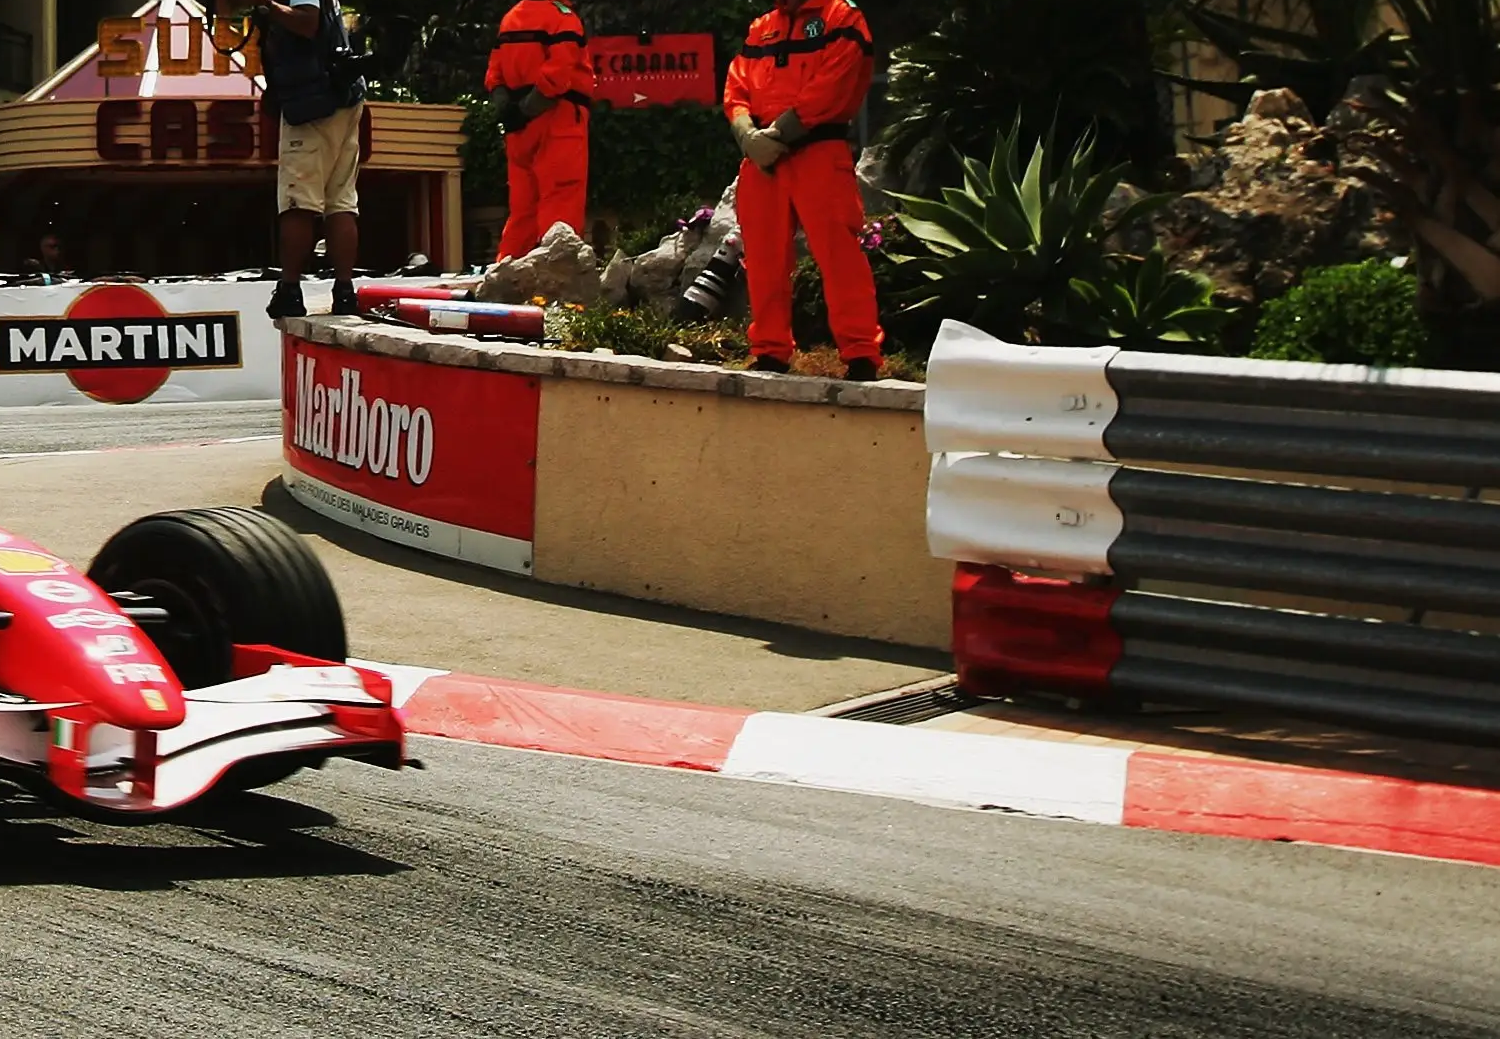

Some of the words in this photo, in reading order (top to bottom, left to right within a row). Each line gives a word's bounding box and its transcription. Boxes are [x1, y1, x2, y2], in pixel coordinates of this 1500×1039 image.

[97, 16, 262, 78] SUN
[96, 99, 373, 161] CASI
[8, 323, 226, 363] MARTINI
[294, 352, 434, 485] Marlboro
[338, 495, 351, 513] DES
[351, 501, 390, 526] MALADIES
[390, 515, 430, 538] GRAVES
